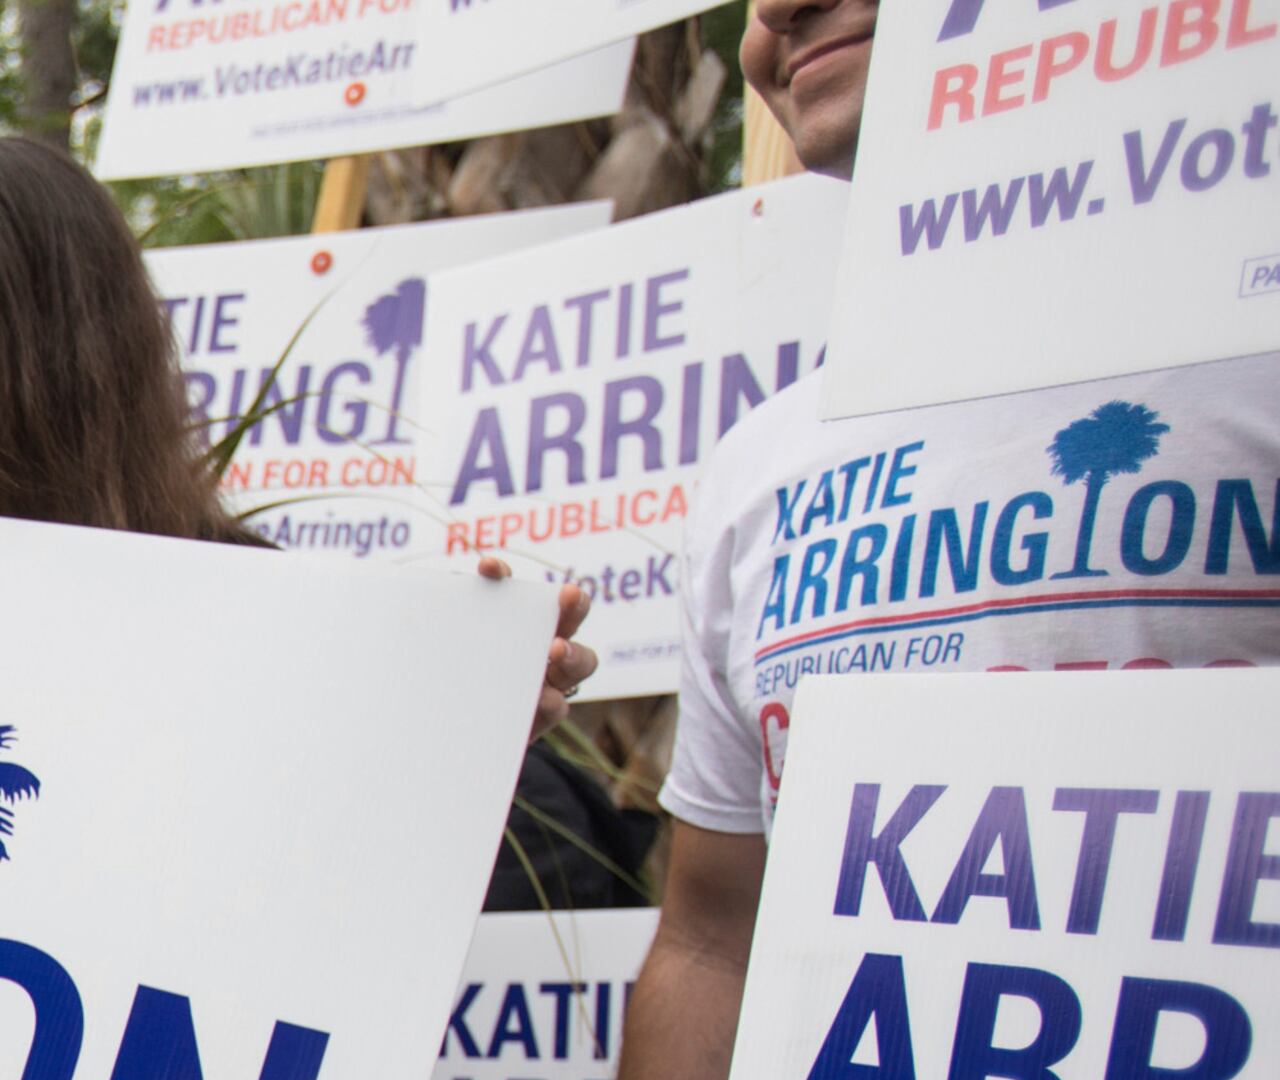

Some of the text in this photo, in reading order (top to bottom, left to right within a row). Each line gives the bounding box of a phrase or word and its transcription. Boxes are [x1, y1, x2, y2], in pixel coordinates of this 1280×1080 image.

[145, 0, 347, 53] REPUBLICAN
[926, 0, 1278, 132] REPUBL
[898, 101, 1280, 257] www.Vot
[460, 267, 690, 394] KATIE
[263, 458, 330, 491] FOR
[448, 339, 827, 508] ARRIN
[445, 484, 692, 558] REPUBLICA
[770, 440, 925, 547] KATIE
[903, 631, 966, 669] FOR
[832, 782, 1280, 949] KATIE
[438, 981, 638, 1060] KATI
